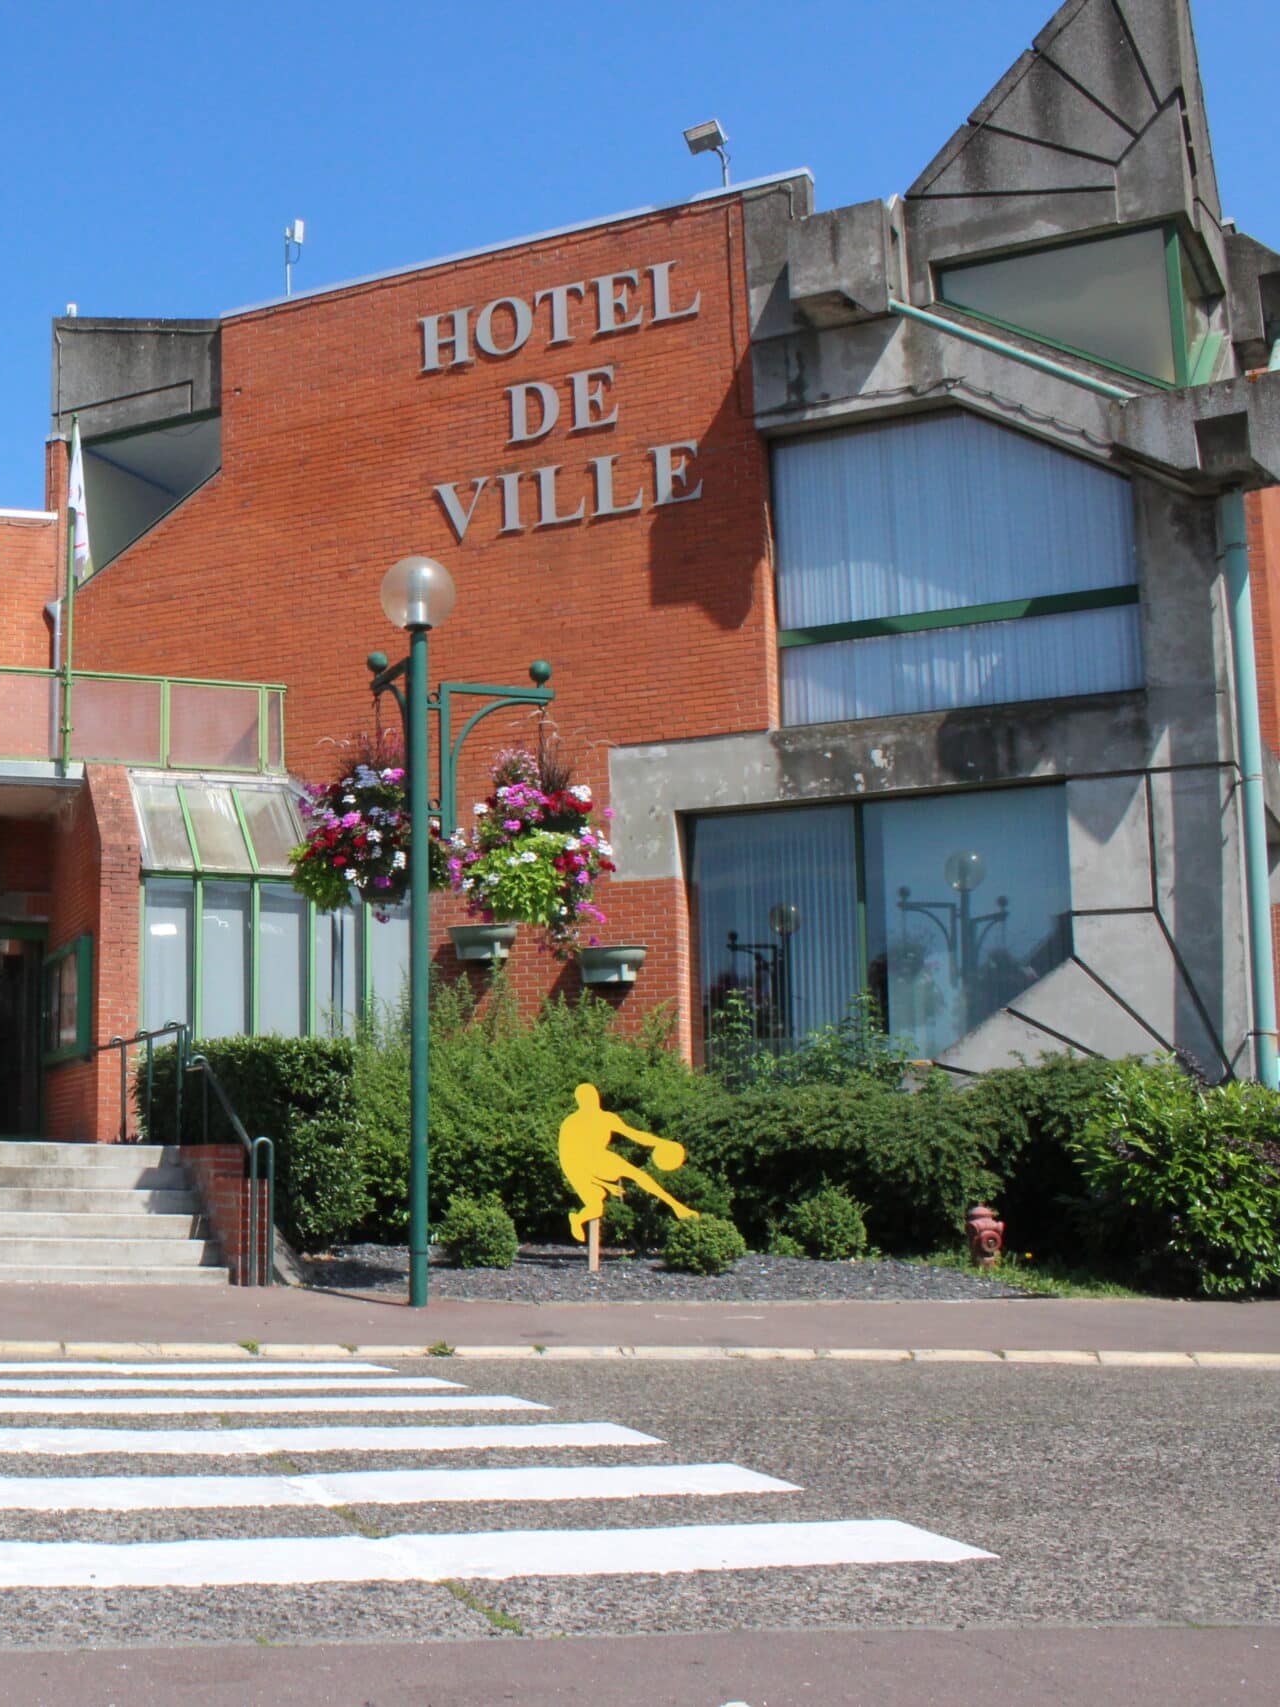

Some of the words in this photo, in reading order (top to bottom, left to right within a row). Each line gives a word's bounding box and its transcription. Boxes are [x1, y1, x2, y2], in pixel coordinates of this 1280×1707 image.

[419, 260, 701, 372] HOTEL
[504, 365, 619, 444] DE
[433, 440, 703, 543] VILLE
